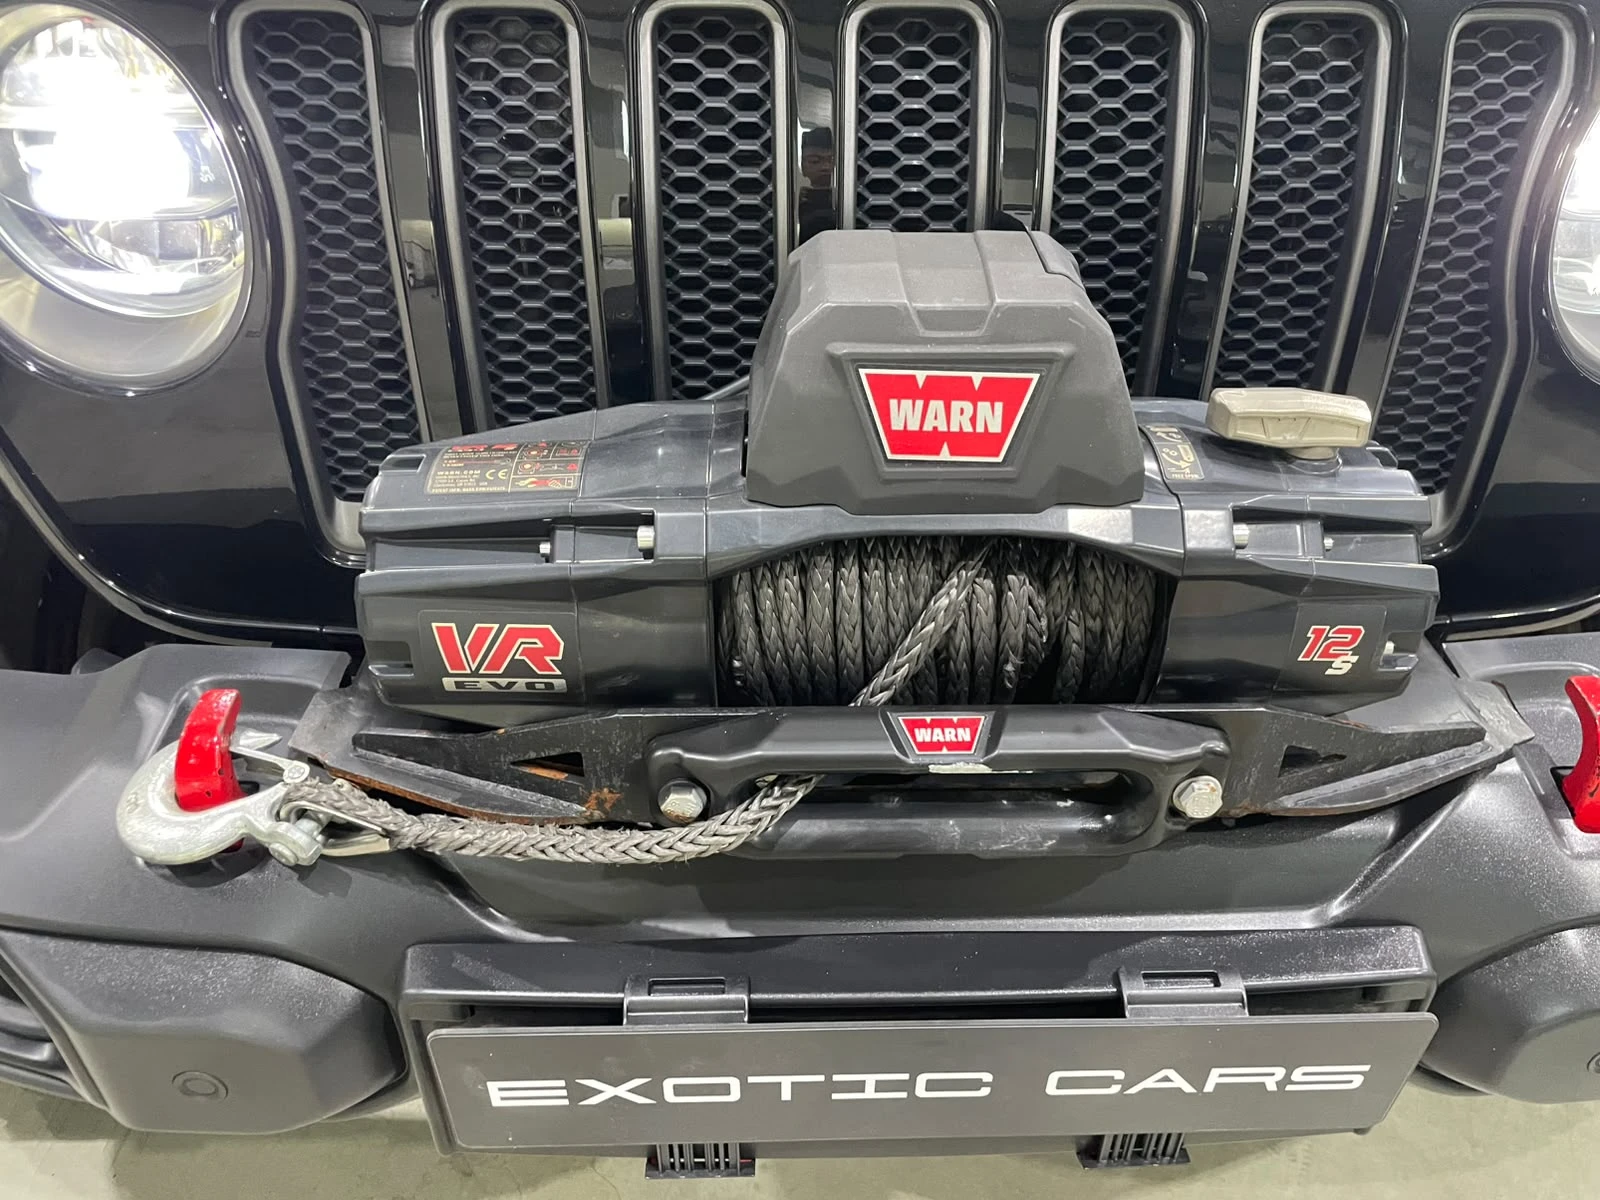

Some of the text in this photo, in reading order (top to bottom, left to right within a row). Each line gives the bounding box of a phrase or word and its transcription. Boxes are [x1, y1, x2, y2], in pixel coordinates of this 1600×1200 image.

[889, 398, 1003, 433] WARN
[431, 622, 565, 675] VR
[1297, 625, 1365, 661] 12
[453, 680, 556, 691] EVO
[913, 727, 972, 743] WARN
[485, 1064, 1372, 1108] EXOTIC CARS
